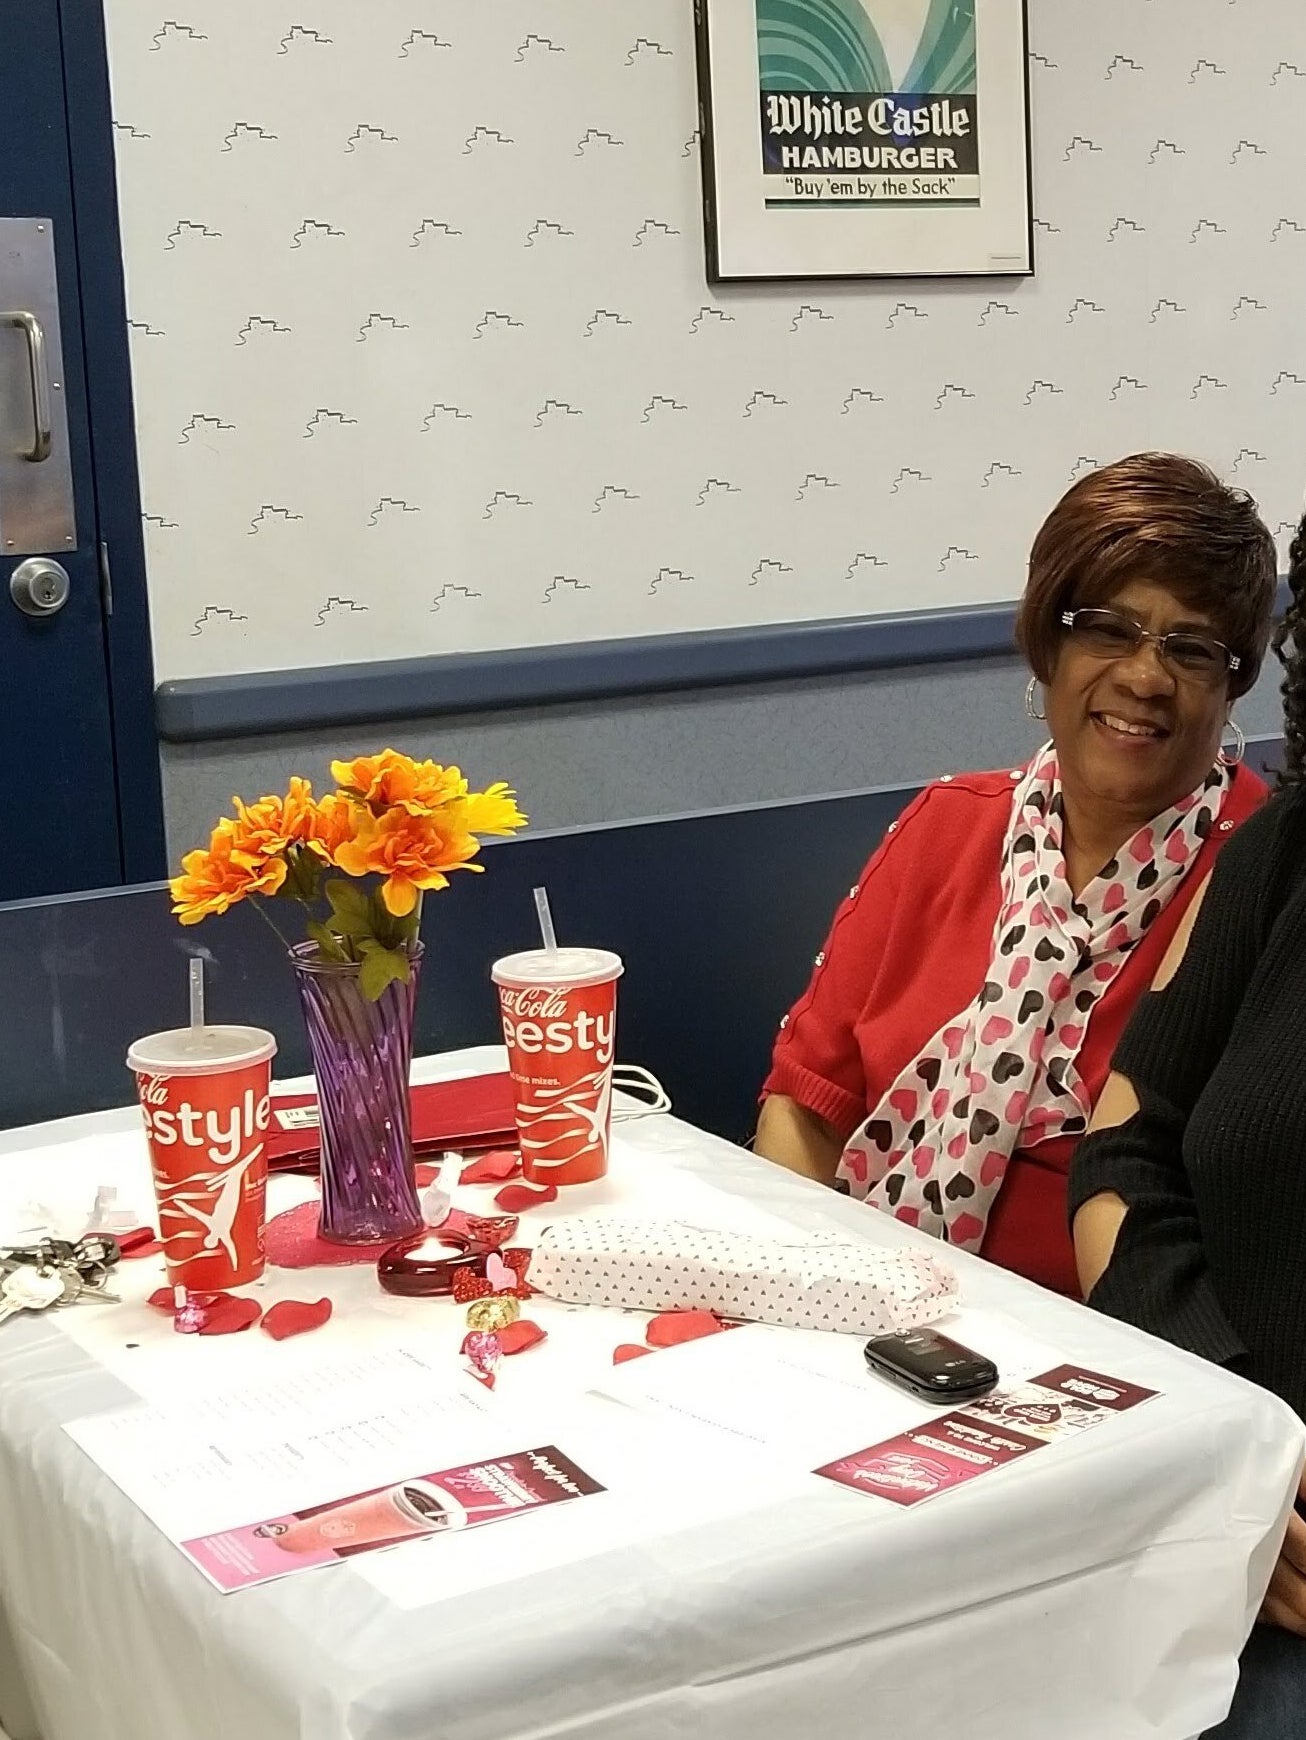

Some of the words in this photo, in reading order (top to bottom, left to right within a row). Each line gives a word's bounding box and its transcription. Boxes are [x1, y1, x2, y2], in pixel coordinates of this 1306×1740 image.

[766, 94, 863, 140] White
[867, 97, 970, 138] Castle
[781, 146, 959, 170] HAMBURGER
[858, 179, 877, 198] by
[882, 179, 908, 195] the
